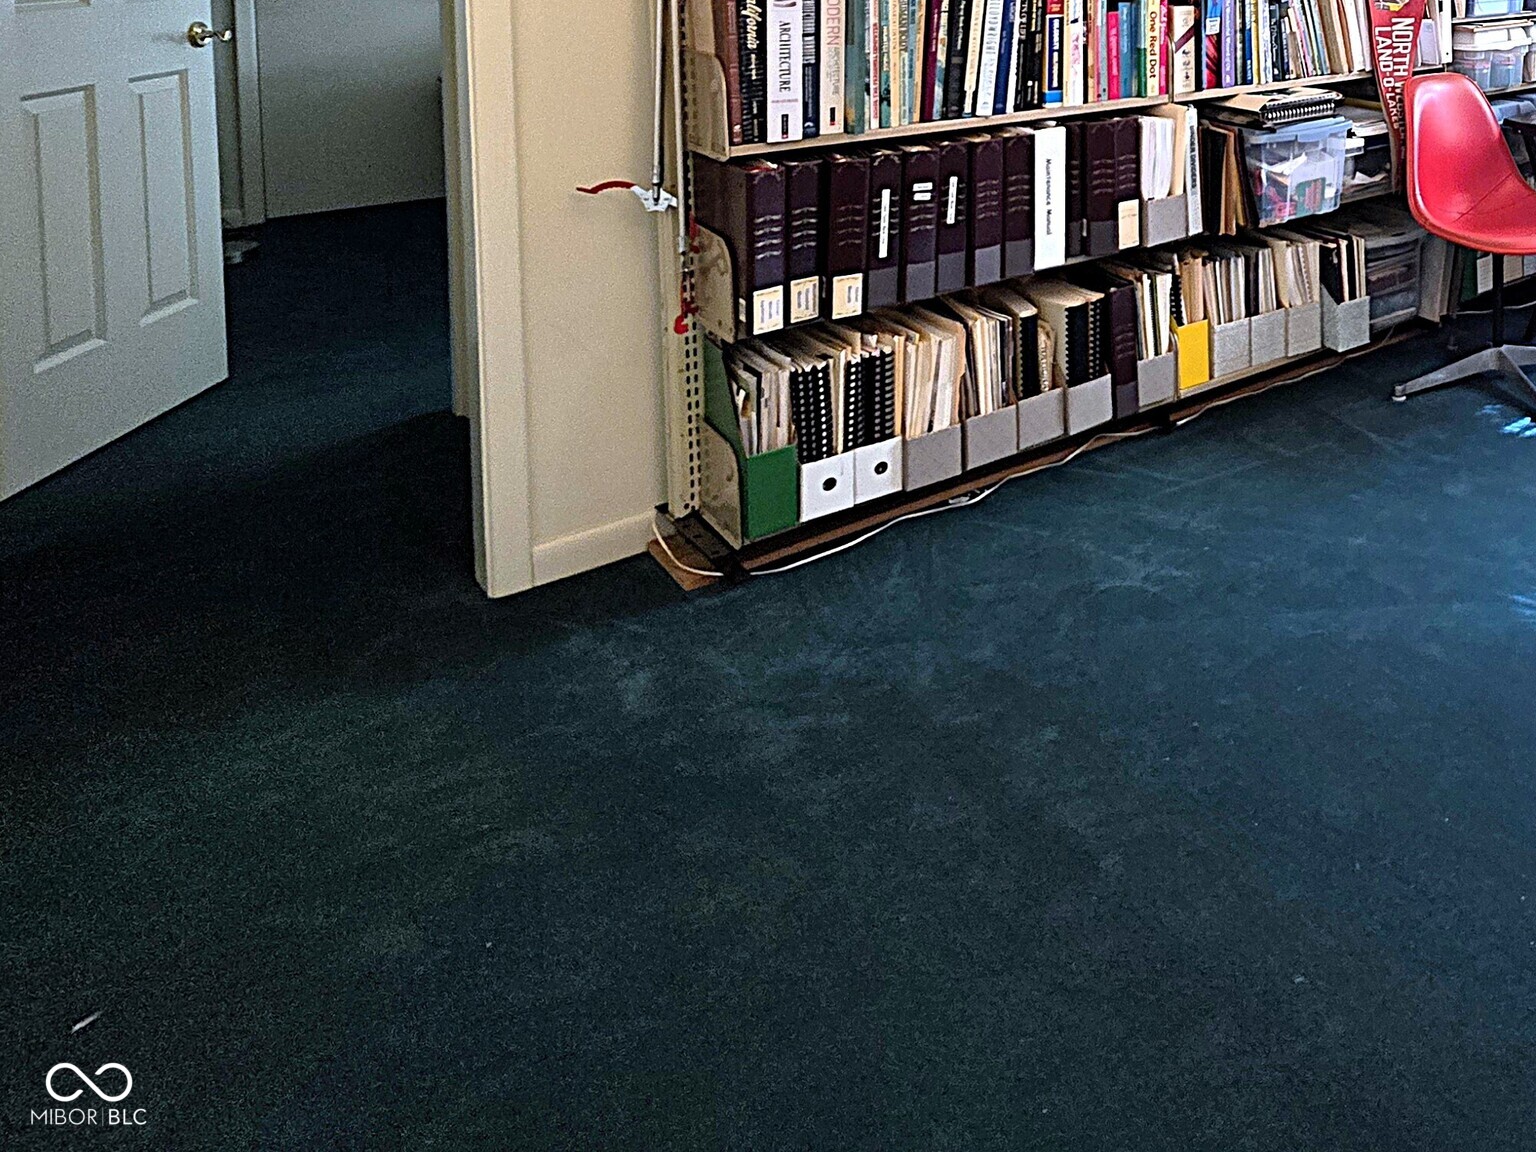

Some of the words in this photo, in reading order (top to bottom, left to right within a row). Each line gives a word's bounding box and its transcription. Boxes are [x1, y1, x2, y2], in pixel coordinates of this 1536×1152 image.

[1020, 12, 1028, 21] OF
[1149, 11, 1158, 32] One
[898, 30, 907, 53] BODY
[1019, 23, 1027, 40] LIFE
[779, 20, 791, 93] ARCHITECTURE
[1149, 35, 1158, 56] Red
[1391, 17, 1415, 76] NORTH
[1149, 59, 1158, 79] Dot
[1374, 26, 1399, 130] LAND-O-LAKES
[1045, 159, 1053, 205] Maintenance
